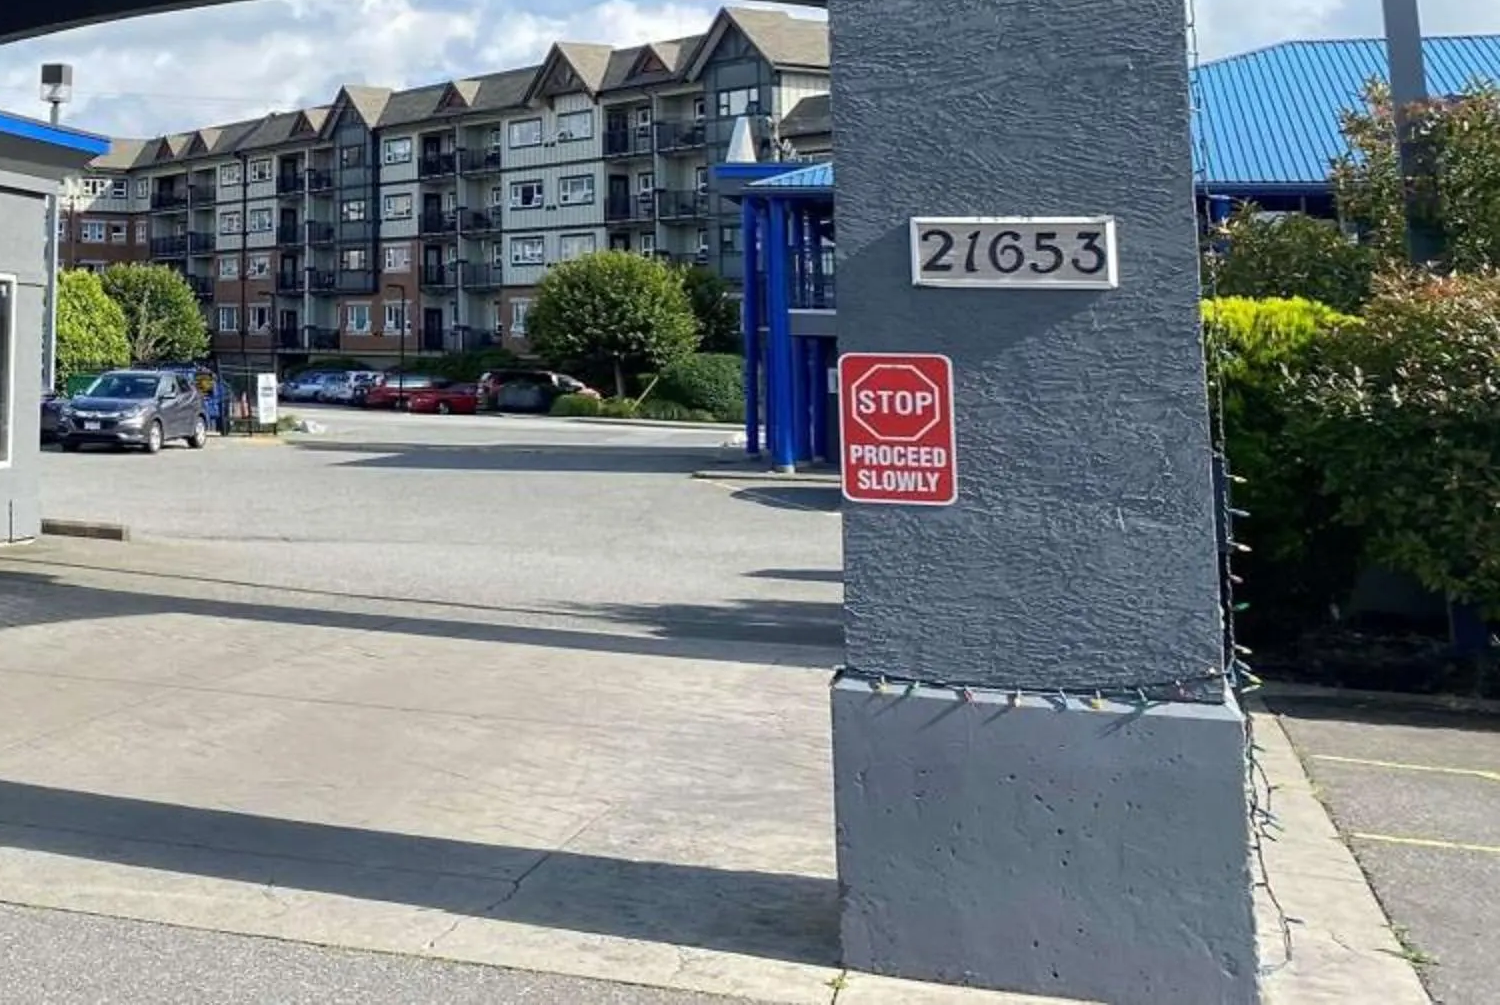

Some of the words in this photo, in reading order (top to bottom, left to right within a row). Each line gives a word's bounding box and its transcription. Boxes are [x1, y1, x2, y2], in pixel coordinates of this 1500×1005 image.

[921, 229, 1106, 274] 21653
[858, 390, 933, 416] STOP
[849, 444, 947, 468] PROCEED
[857, 469, 941, 492] SLOWLY
